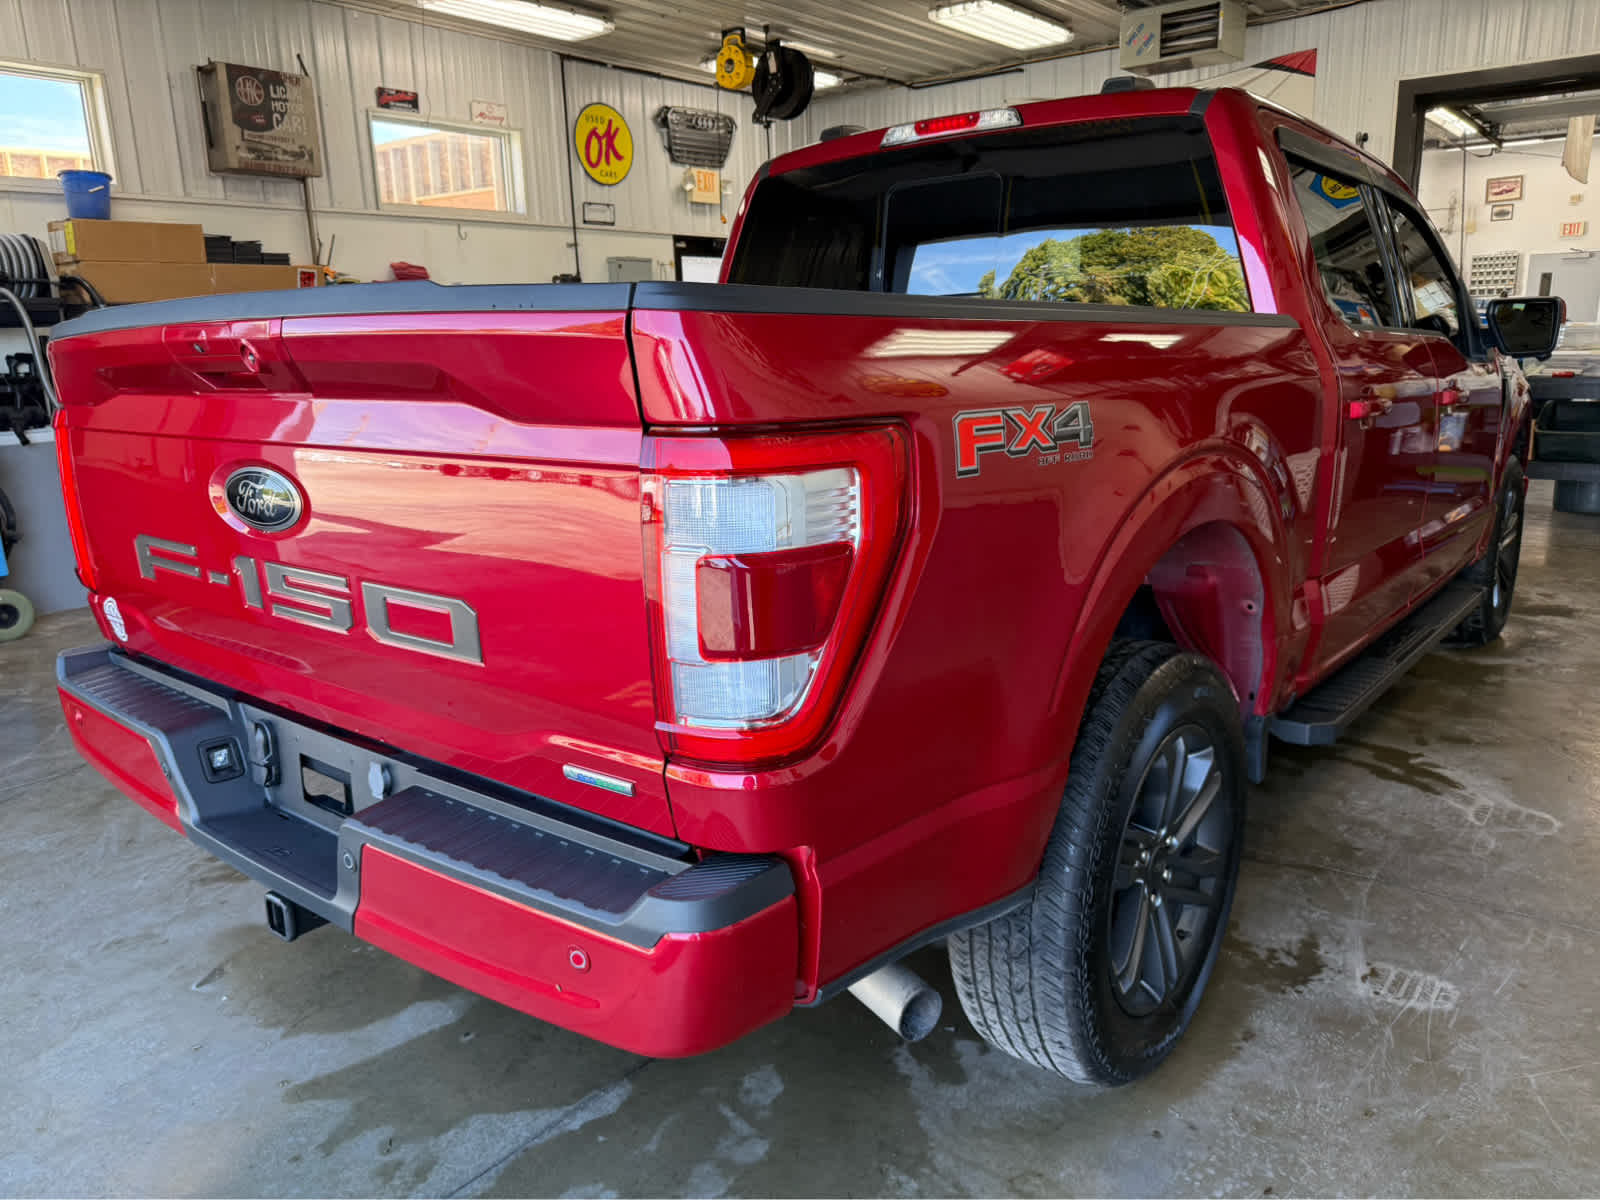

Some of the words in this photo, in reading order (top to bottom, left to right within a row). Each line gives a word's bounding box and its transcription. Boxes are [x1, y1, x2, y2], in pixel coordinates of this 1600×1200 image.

[585, 114, 605, 124] USED
[585, 118, 624, 168] OK
[696, 170, 716, 192] EXIT
[1563, 222, 1581, 235] EXIT
[952, 401, 1094, 479] FX4
[237, 480, 277, 518] Ford
[133, 533, 485, 667] F-150
